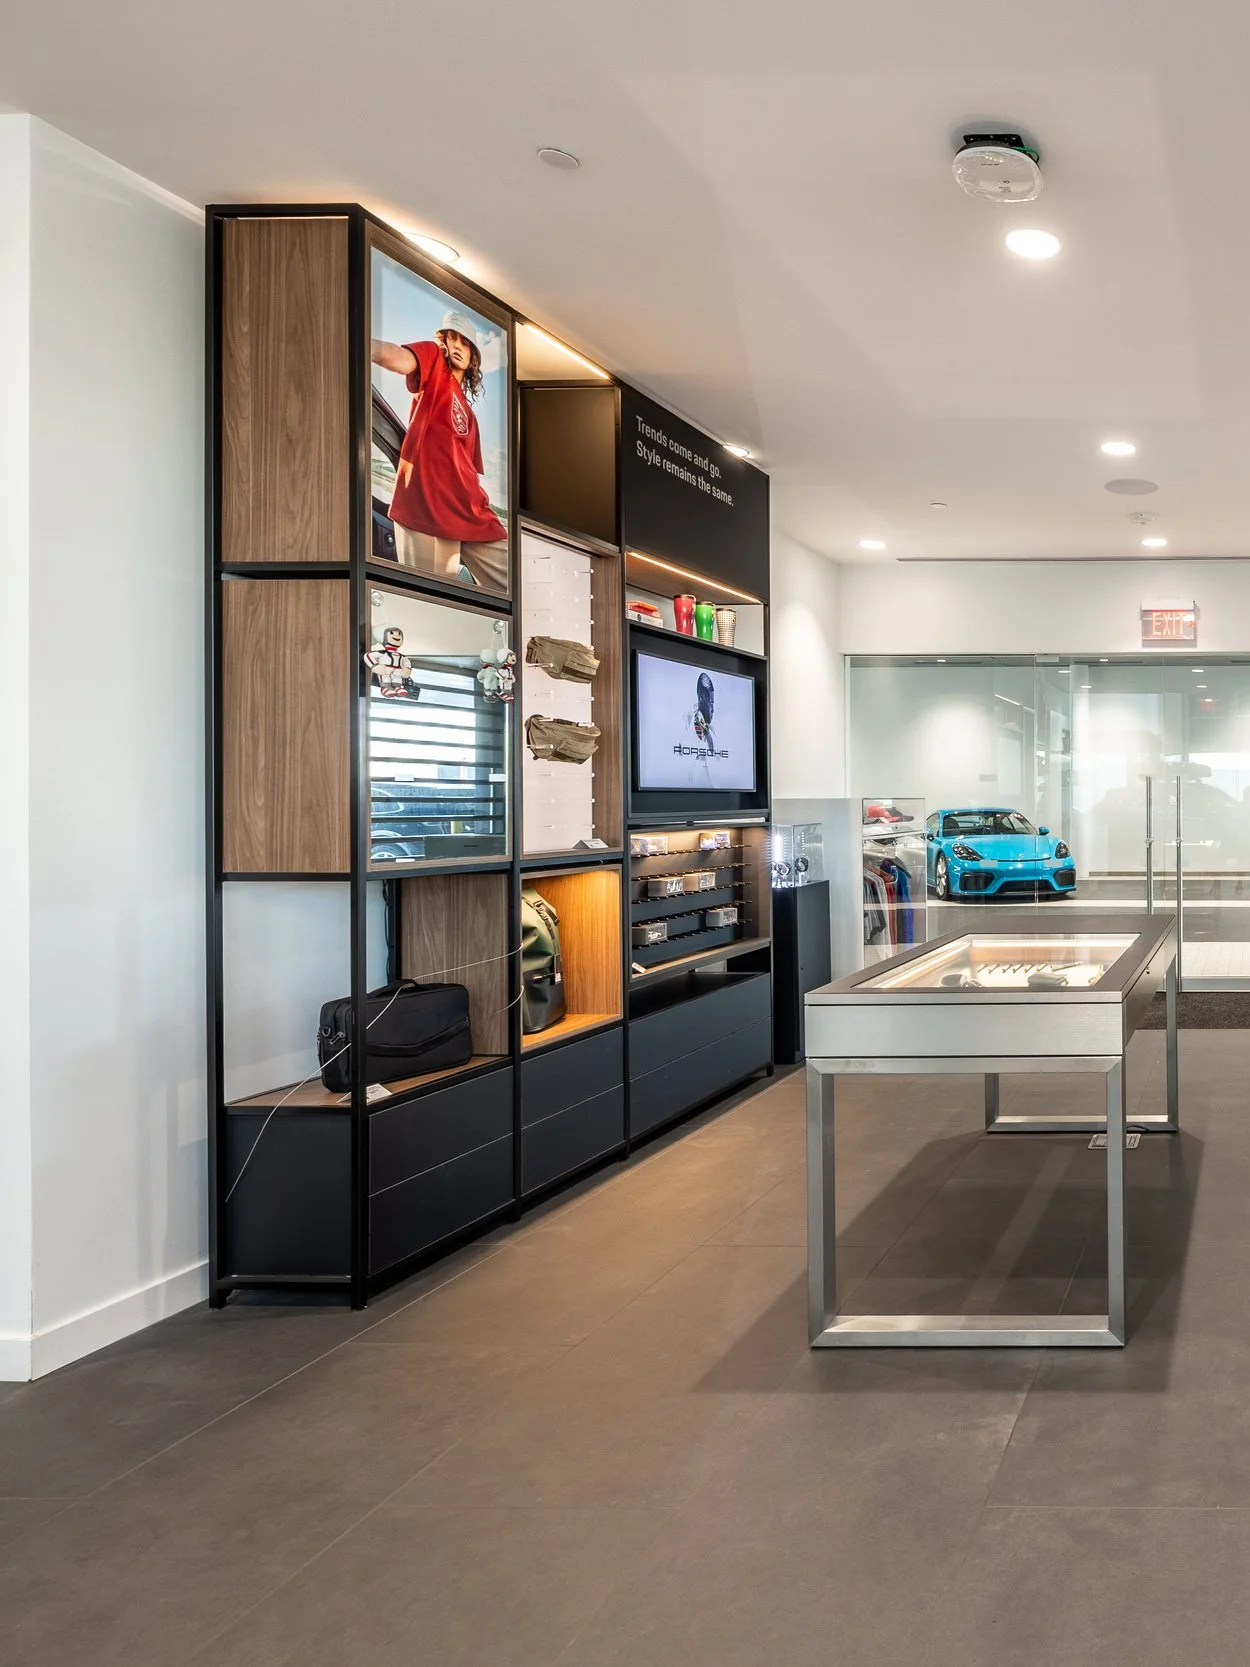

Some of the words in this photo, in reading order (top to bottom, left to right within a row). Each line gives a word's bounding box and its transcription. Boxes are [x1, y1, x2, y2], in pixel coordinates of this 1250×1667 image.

[636, 415, 668, 447] Trends
[668, 438, 692, 462] come
[693, 453, 709, 472] and
[709, 464, 722, 480] go.
[636, 440, 661, 467] Style
[662, 458, 697, 487] remains
[697, 476, 711, 494] the
[711, 486, 734, 507] same.
[1152, 611, 1186, 636] EXIT
[674, 746, 728, 758] PORSCHE
